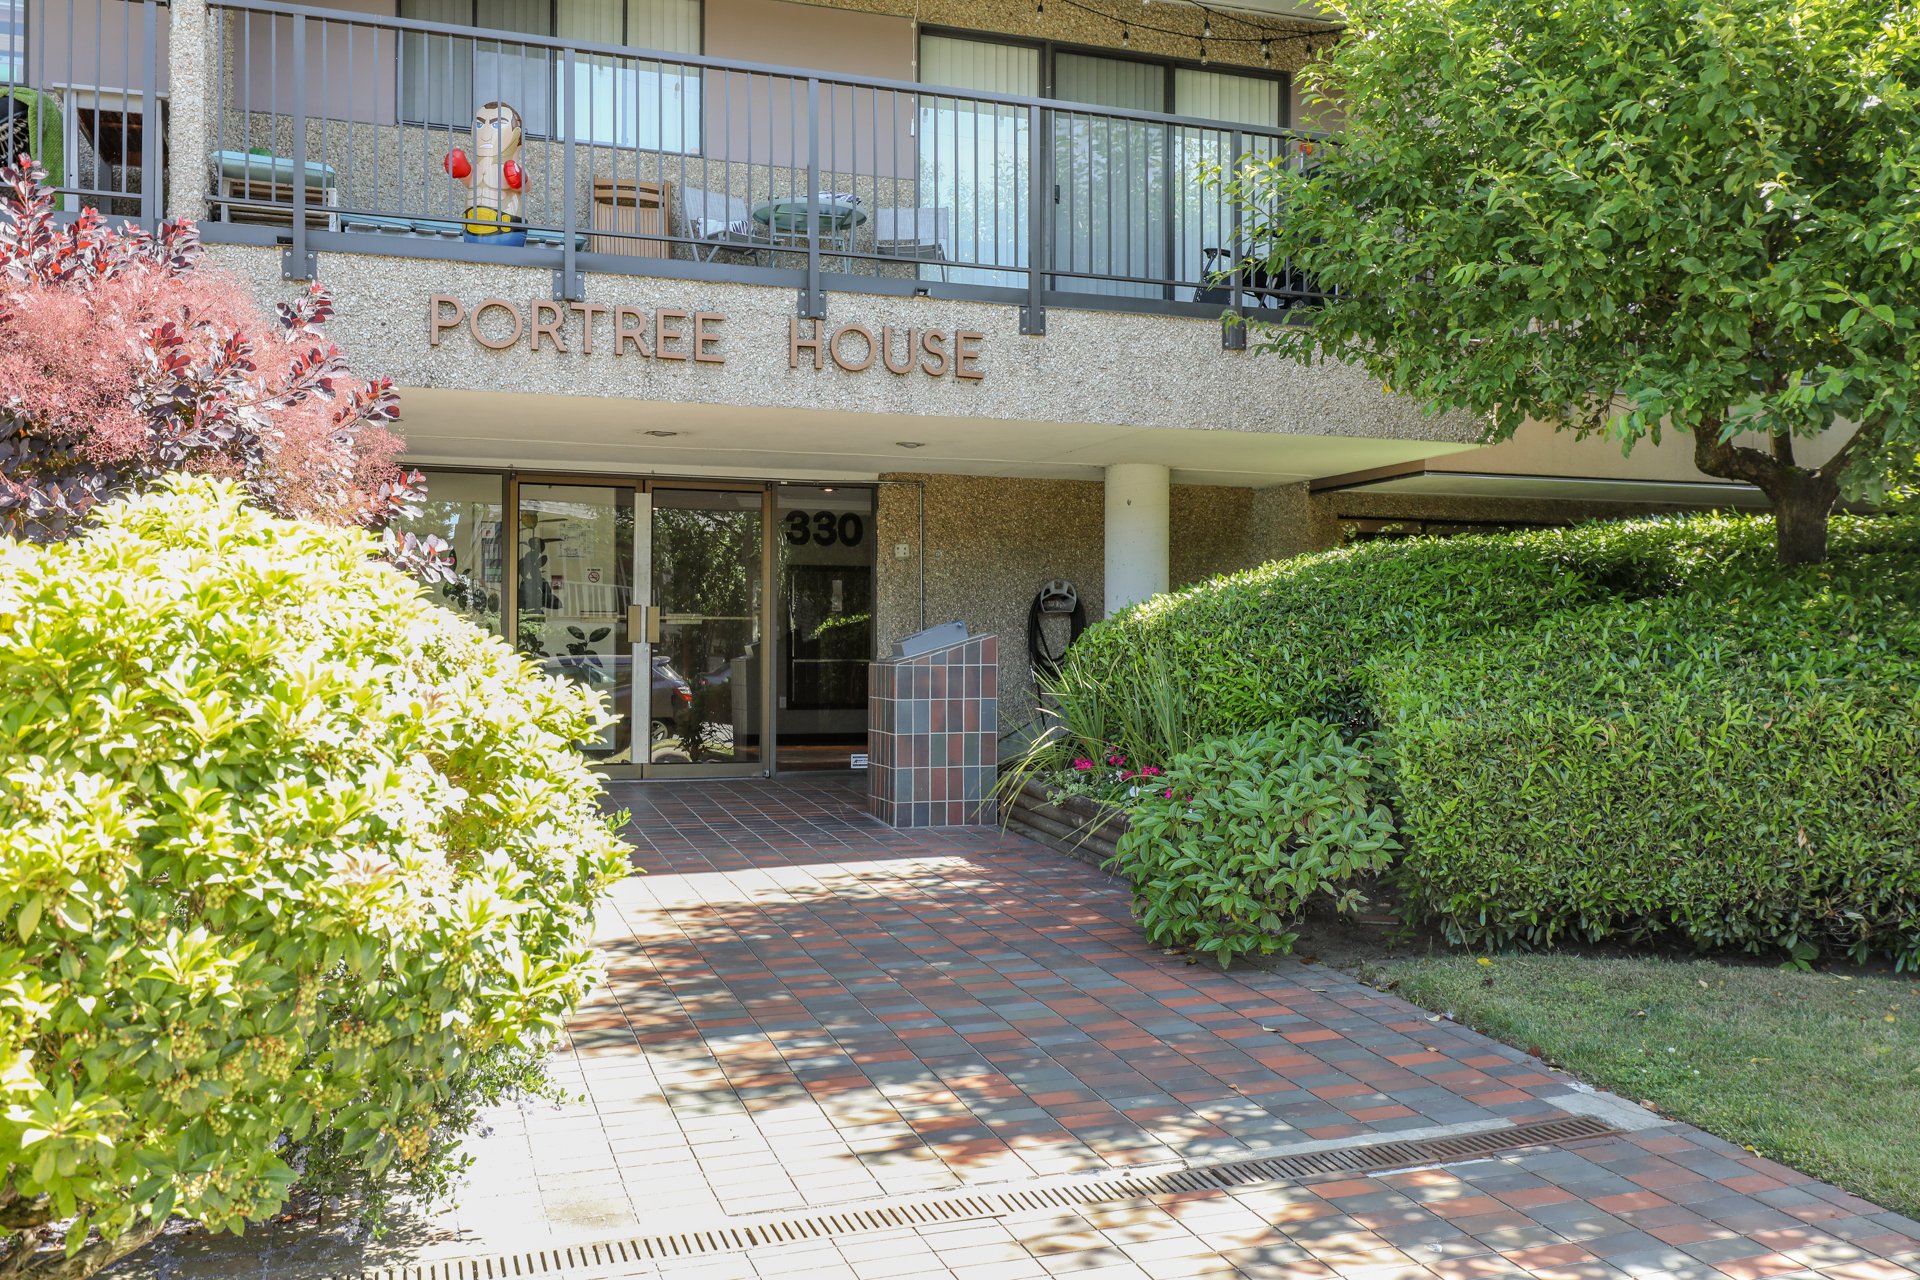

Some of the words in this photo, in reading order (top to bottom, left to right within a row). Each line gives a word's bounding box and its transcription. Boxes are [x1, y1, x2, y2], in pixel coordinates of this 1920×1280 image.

[429, 293, 725, 363] PORTREE
[789, 318, 984, 380] HOUSE
[785, 510, 863, 547] 330
